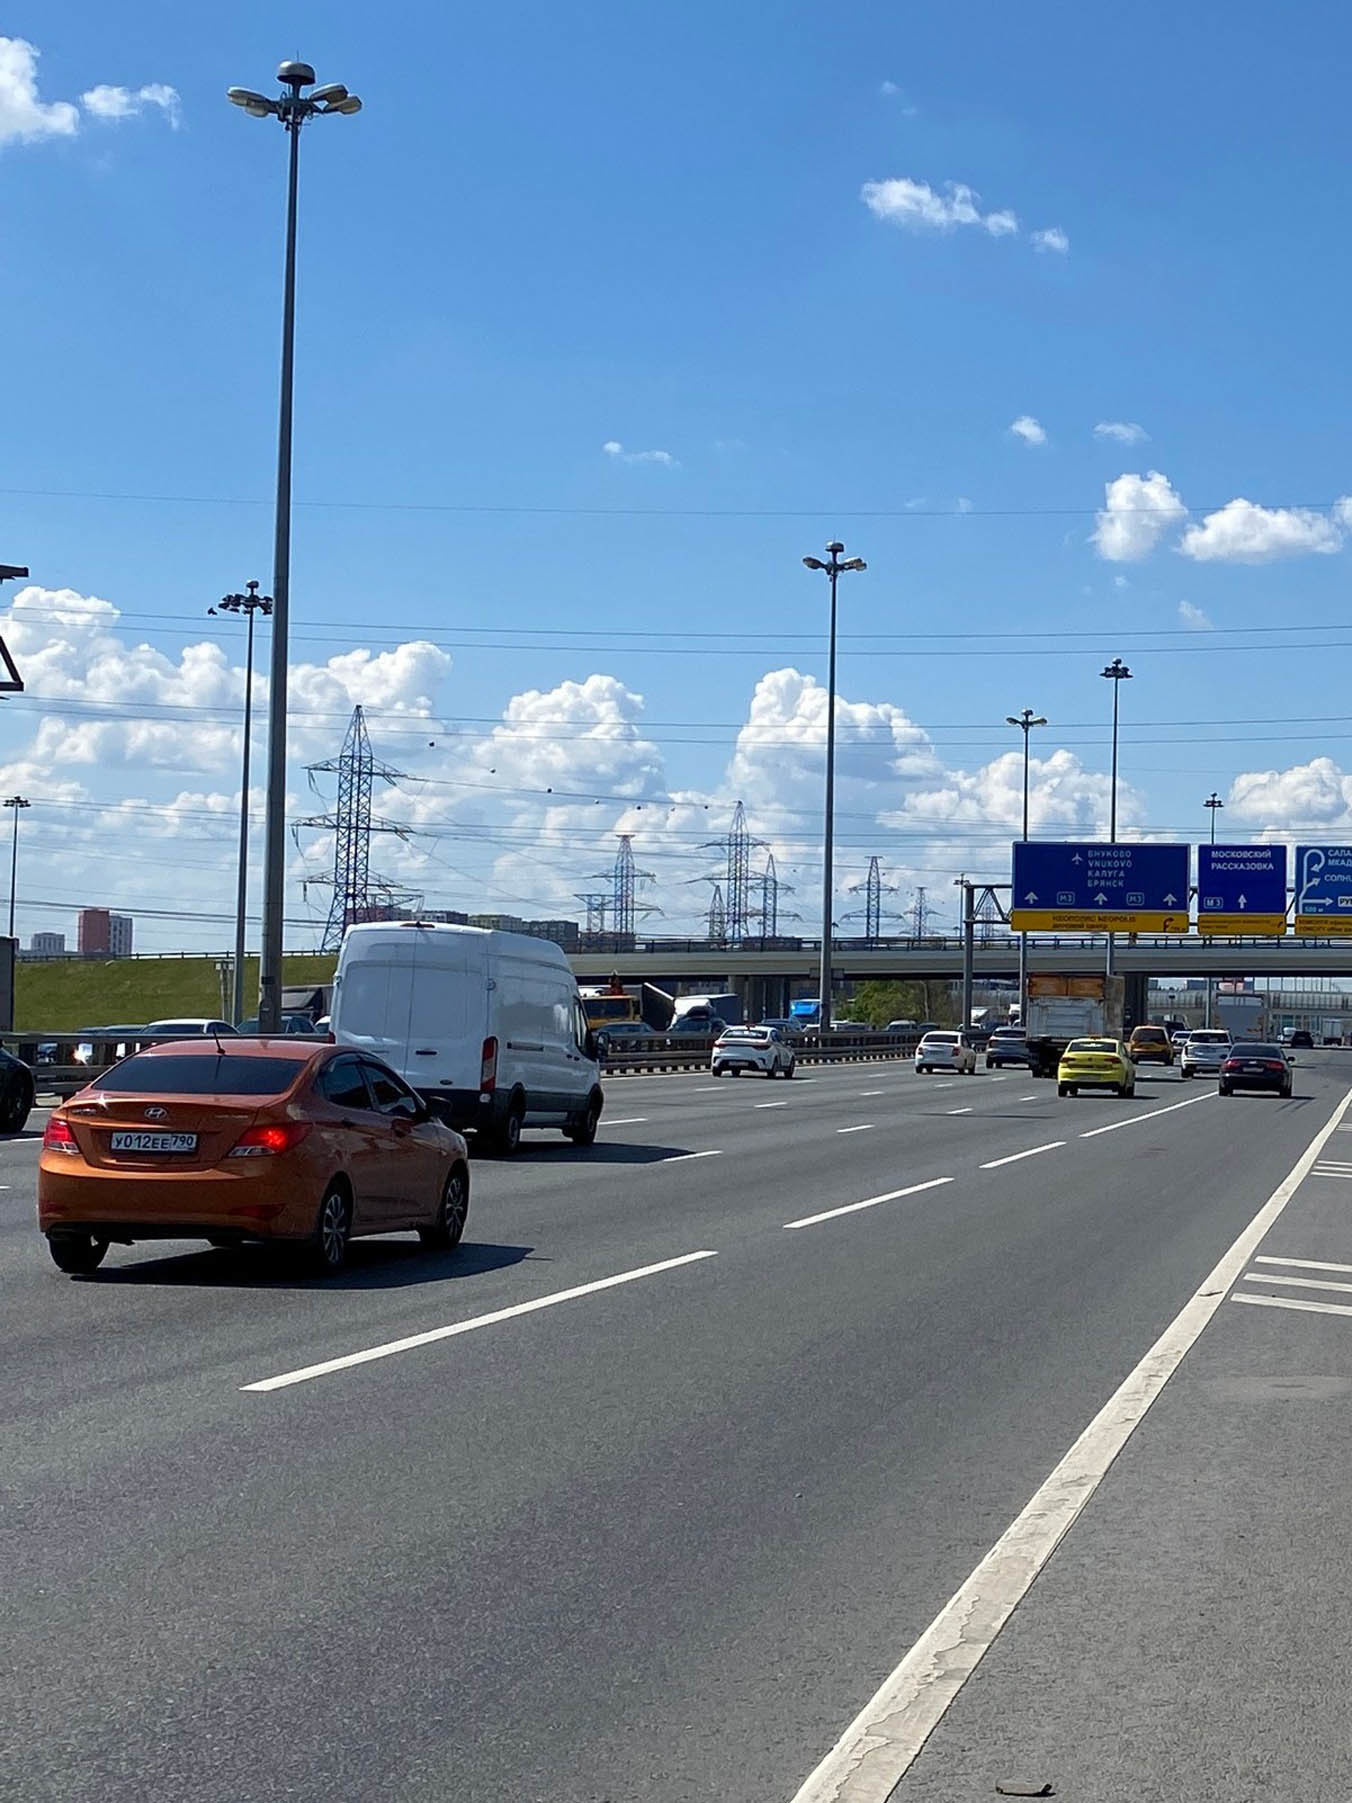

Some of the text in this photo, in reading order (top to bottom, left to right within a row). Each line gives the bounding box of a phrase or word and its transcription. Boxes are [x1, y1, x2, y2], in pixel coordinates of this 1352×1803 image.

[1087, 850, 1132, 859] ВНУКОВО
[1211, 849, 1272, 859] МОСКОВСКИЙ
[1088, 860, 1132, 868] VNUKOVO
[1211, 862, 1274, 871] РАССКАЗОВКА
[1328, 859, 1352, 868] МКАД
[1087, 870, 1125, 878] КАЛУГА
[1087, 879, 1125, 888] БРЯНСК
